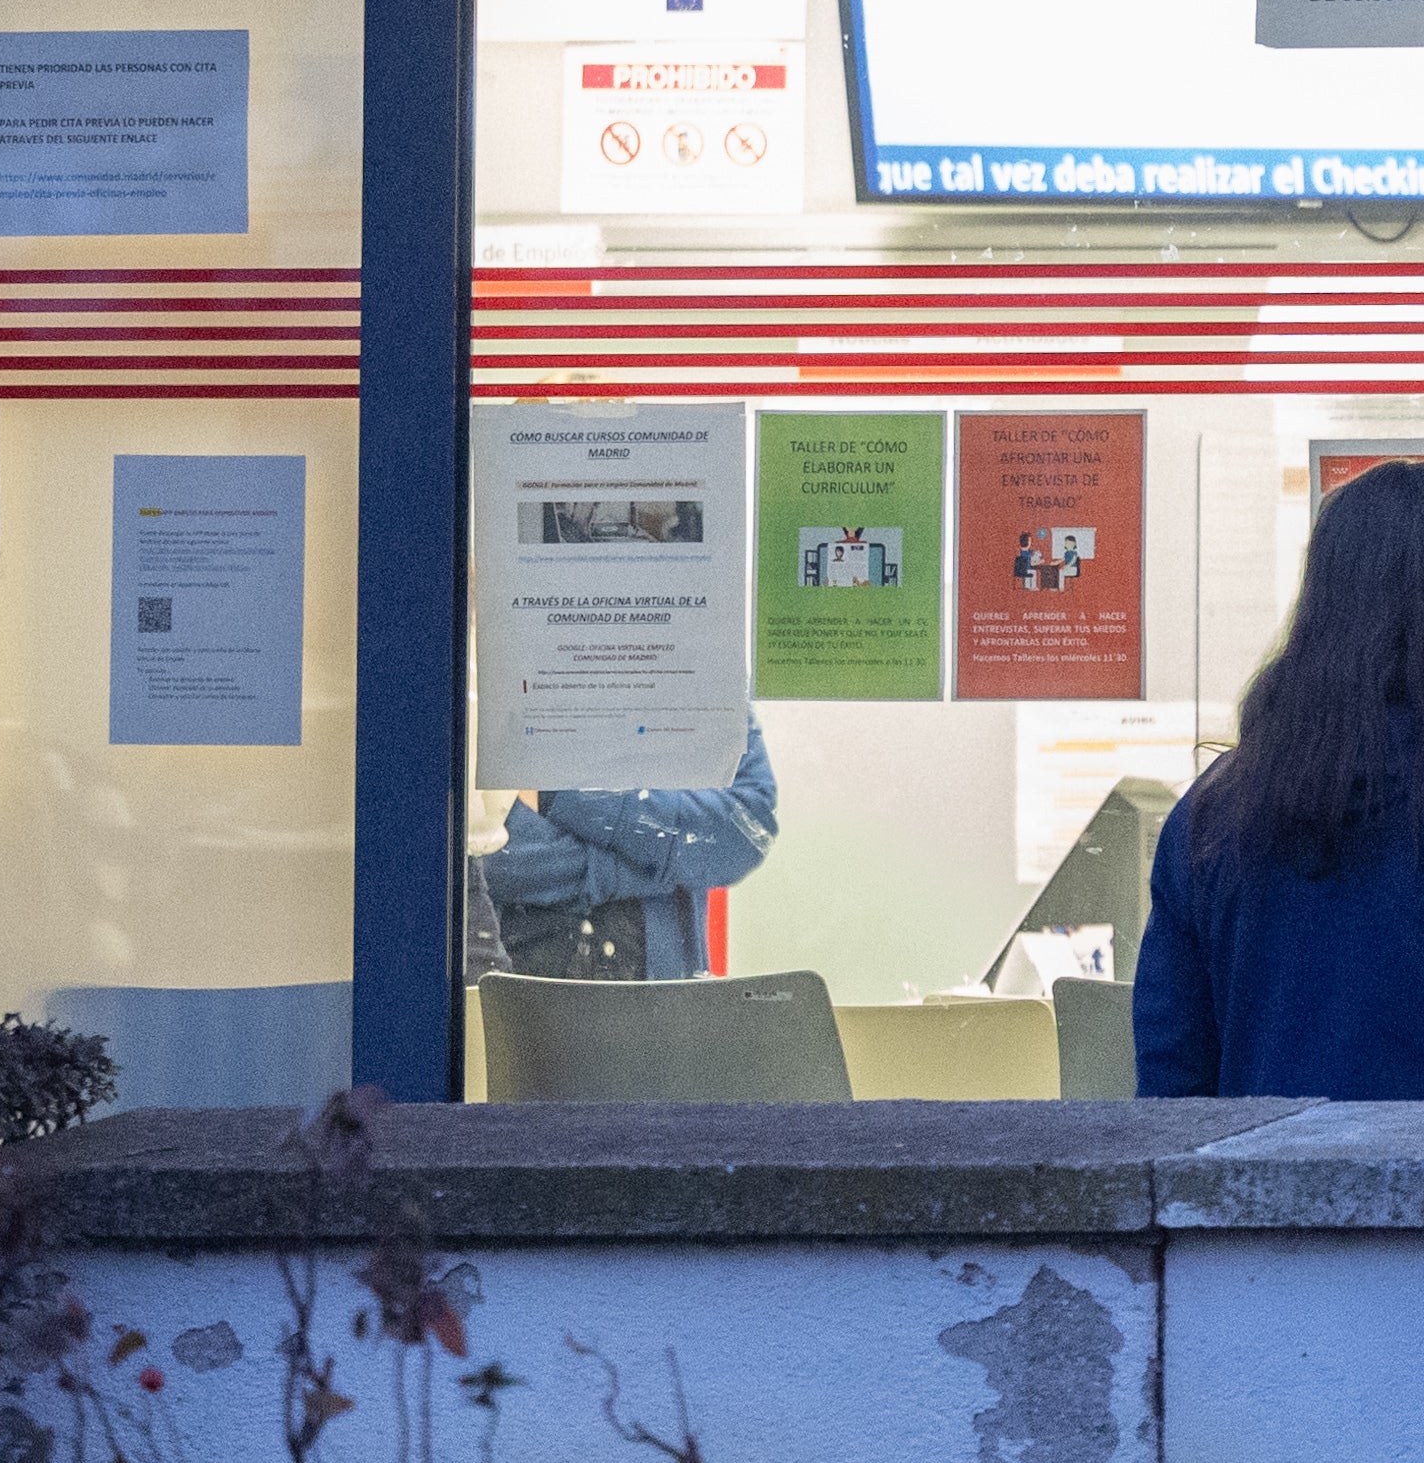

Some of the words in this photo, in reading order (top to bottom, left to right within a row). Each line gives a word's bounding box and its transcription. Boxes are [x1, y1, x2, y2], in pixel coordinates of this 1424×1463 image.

[0, 64, 35, 74] TIENEN
[37, 63, 93, 73] PRIORIDAD
[95, 63, 112, 73] LAS
[115, 63, 168, 73] PERSONAS
[169, 62, 191, 72] CON
[194, 62, 217, 72] CITA
[613, 63, 757, 90] PROHIBIDO
[0, 80, 35, 90] PREVIA
[29, 119, 58, 128] PEDIR
[60, 118, 82, 127] CITA
[85, 118, 120, 127] PREVIA
[123, 118, 135, 127] LO
[138, 118, 178, 127] PUEDEN
[181, 117, 213, 126] HACER
[46, 135, 64, 143] DEL
[66, 134, 117, 143] SIGUIENTE
[120, 134, 157, 143] ENLACE
[939, 153, 983, 192] tal
[990, 158, 1047, 192] vez
[1053, 153, 1136, 194] deba
[1143, 155, 1265, 195] realizar
[1271, 155, 1304, 195] el
[510, 431, 542, 442] CÓMO
[544, 431, 584, 442] BUSCAR
[586, 431, 624, 442] CURSOS
[627, 431, 693, 442] COMUNIDAD
[695, 431, 709, 442] DE
[993, 430, 1038, 442] TALLER
[1041, 430, 1058, 442] DE
[790, 440, 836, 454] TALLER
[839, 440, 856, 454] DE
[587, 448, 631, 458] MADRID
[1000, 453, 1069, 464] AFRONTAR
[1072, 453, 1102, 464] UNA
[802, 462, 871, 474] ELABORAR
[875, 462, 894, 474] UN
[1002, 474, 1078, 486] ENTREVISTA
[1082, 474, 1099, 486] DE
[511, 598, 520, 606] A
[522, 598, 560, 606] TRAVÉS
[561, 598, 575, 606] DE
[577, 598, 589, 606] LA
[591, 598, 632, 606] OFICINA
[634, 598, 677, 606] VIRTUAL
[678, 598, 692, 606] DE
[694, 598, 707, 606] LA
[547, 613, 612, 623] COMUNIDAD
[614, 613, 627, 623] DE
[629, 613, 672, 623] MADRID
[1042, 638, 1060, 646] CON
